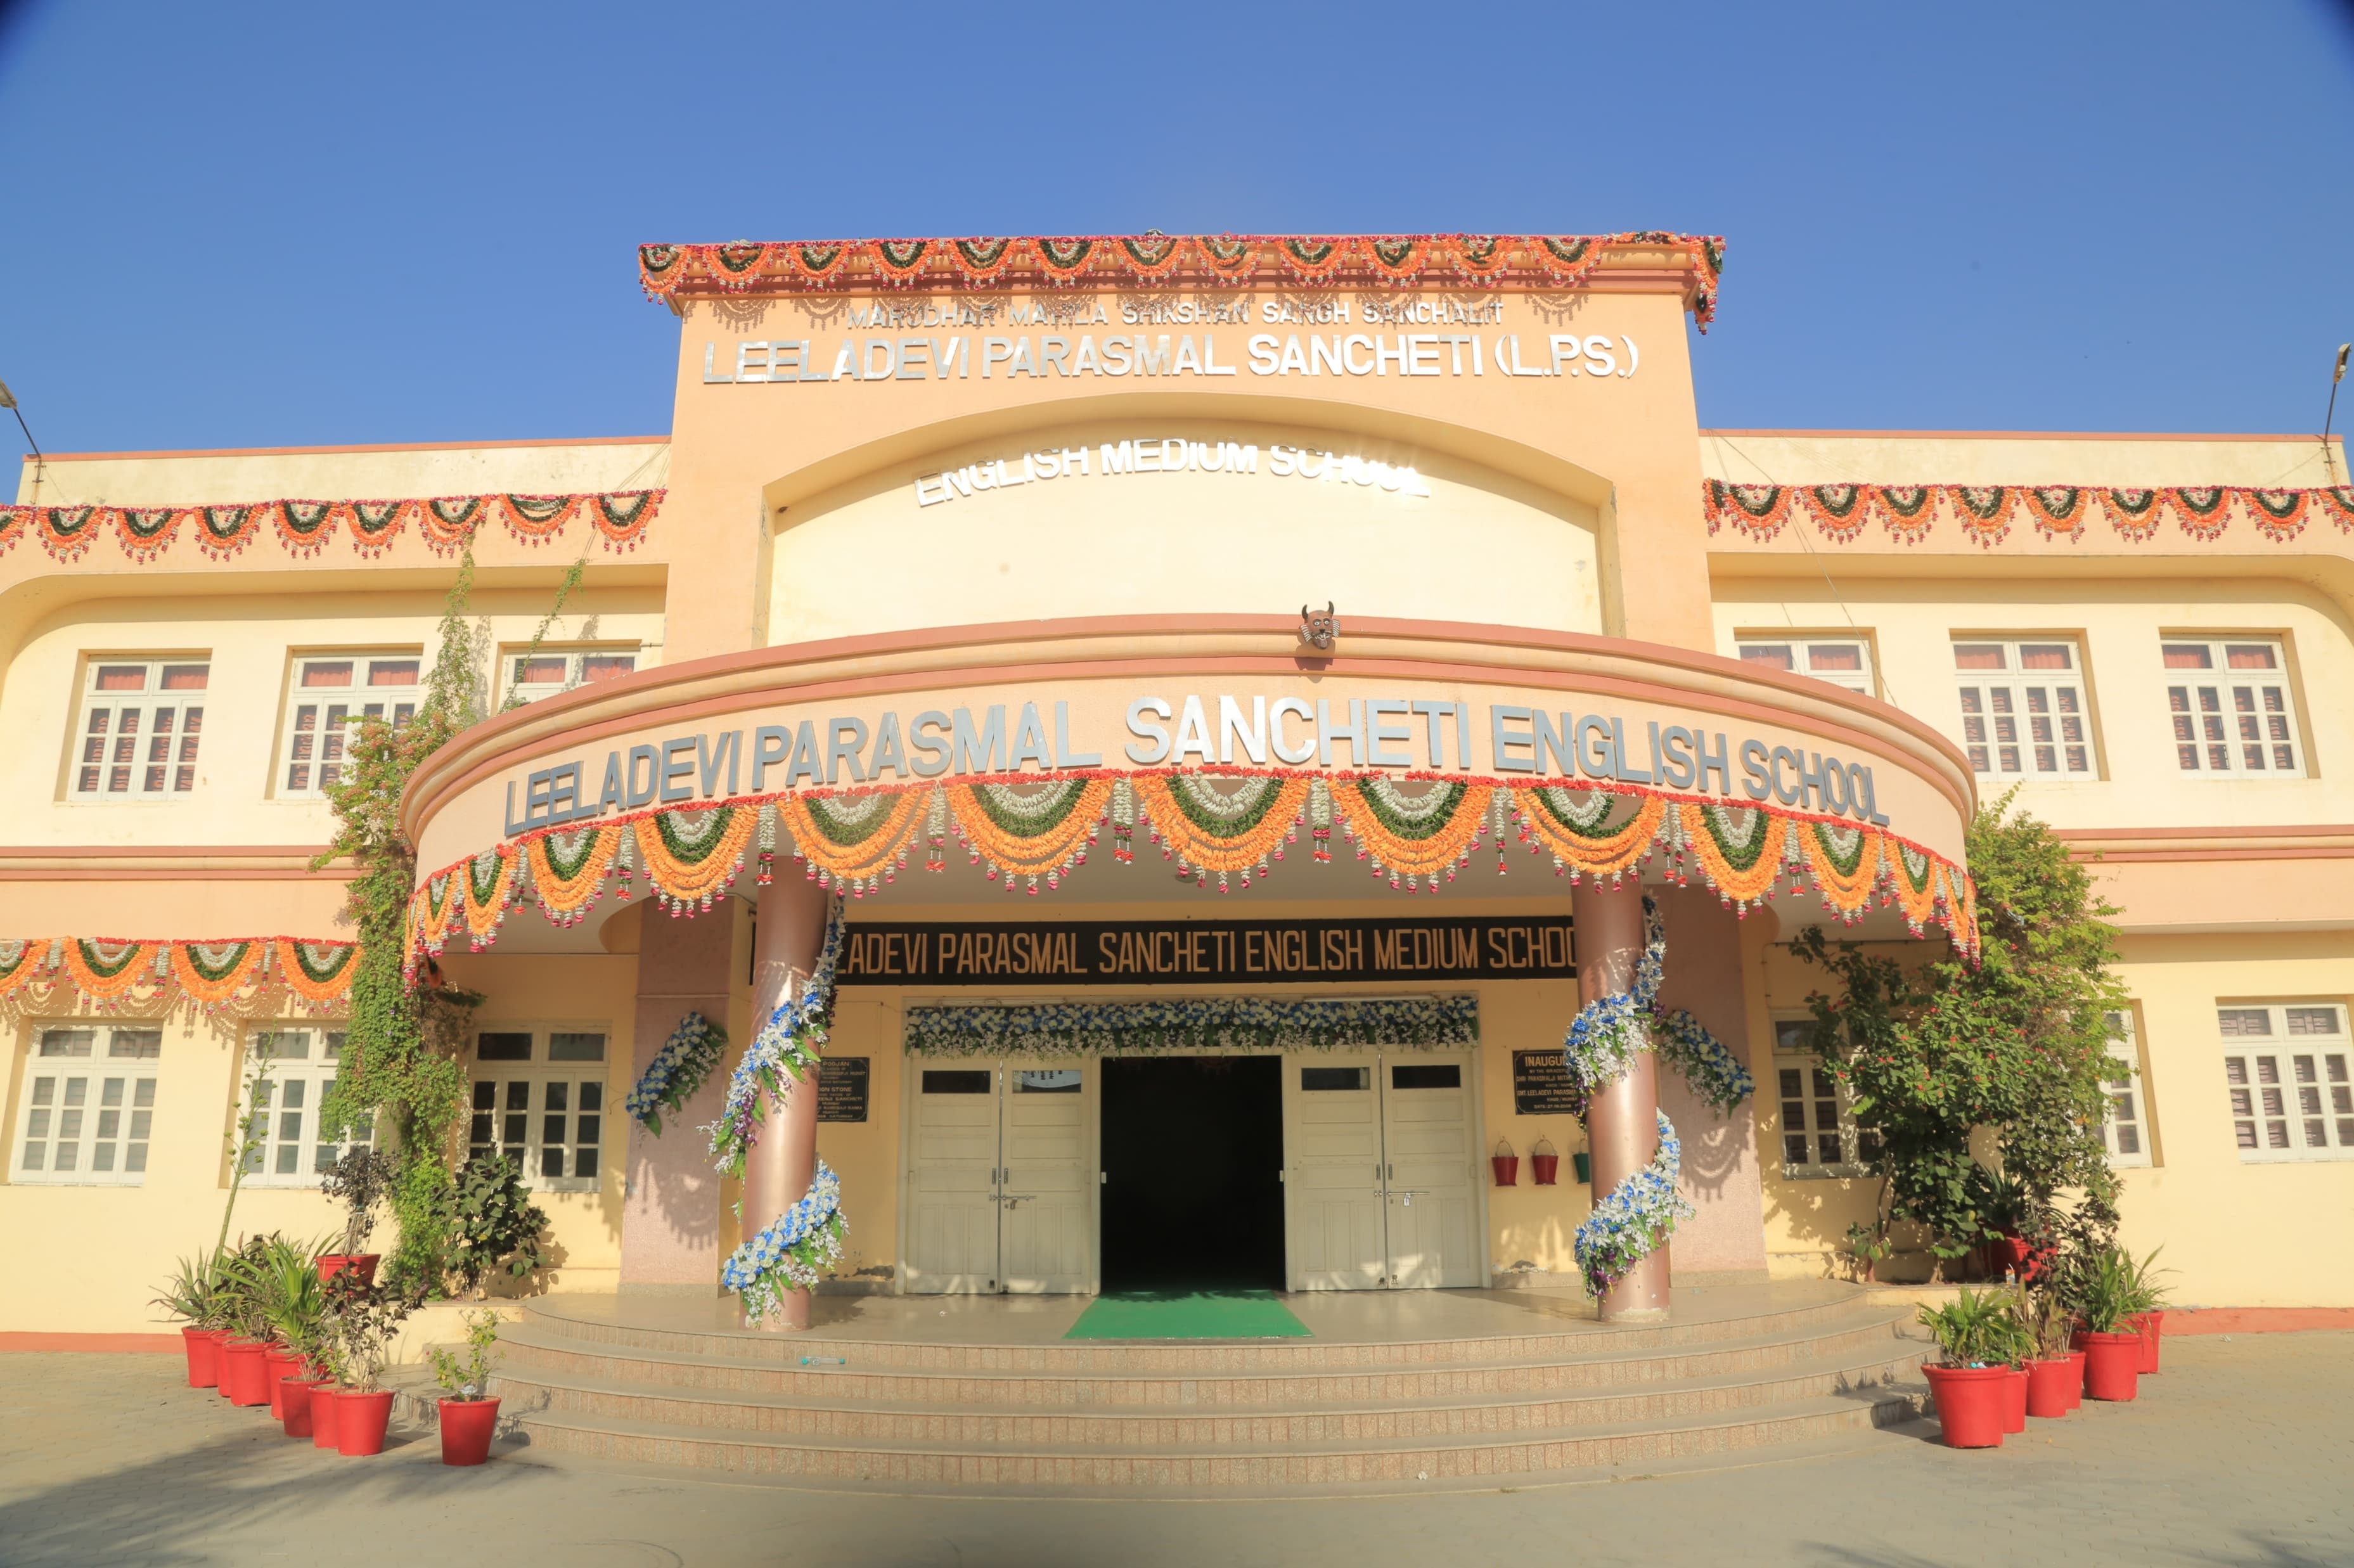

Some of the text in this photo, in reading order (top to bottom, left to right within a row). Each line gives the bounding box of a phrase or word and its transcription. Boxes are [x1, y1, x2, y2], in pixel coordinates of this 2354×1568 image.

[847, 301, 1503, 329] MARUDHAR MAHILA SHIKSHAN SANGH SANCHALIT
[704, 334, 1639, 384] LEELADEVI PARASMAL SANCHETI (L.P.S.)
[913, 437, 1431, 508] ENGLISH MEDIUM SCHOOL
[505, 695, 1890, 836] LEELADEVI PARASMAL SANCHETI ENGLISH SCHOOL
[939, 932, 1088, 974] PARASMAL
[1099, 931, 1235, 973] SANCHETI
[1245, 929, 1363, 972] ENGLISH
[1373, 927, 1479, 971] MEDIUM
